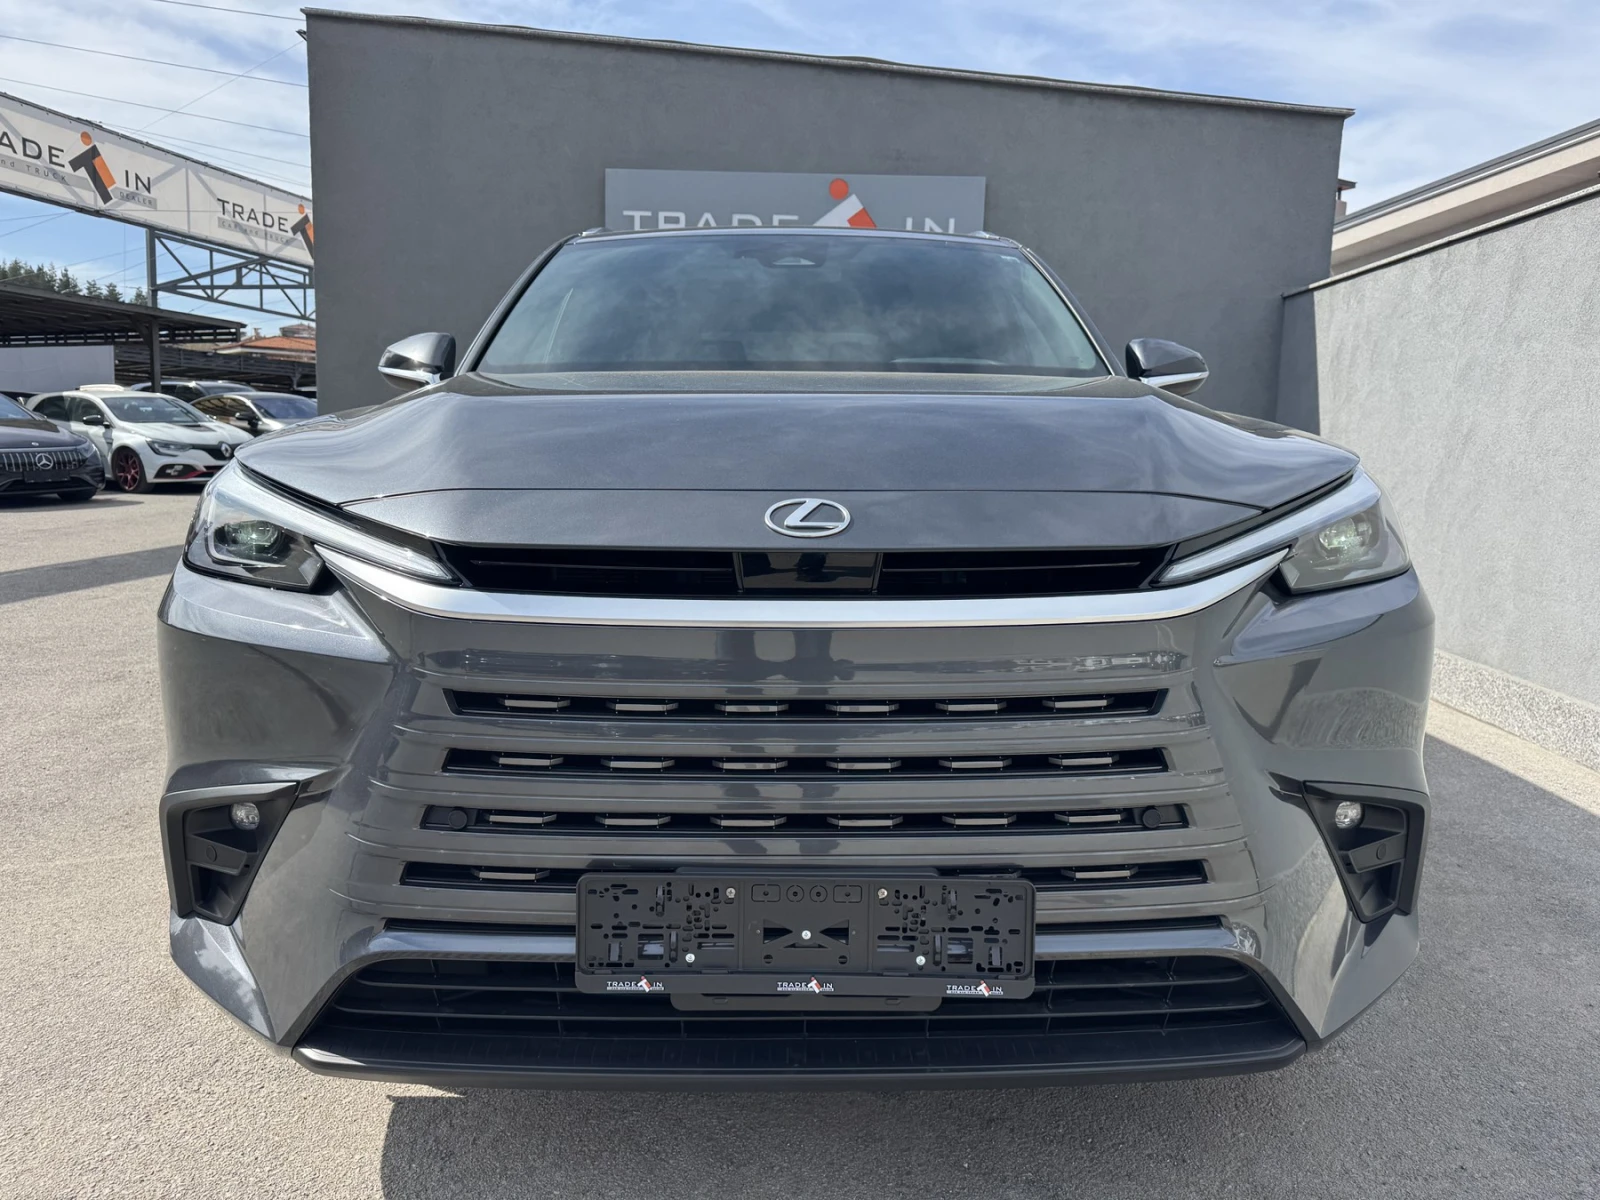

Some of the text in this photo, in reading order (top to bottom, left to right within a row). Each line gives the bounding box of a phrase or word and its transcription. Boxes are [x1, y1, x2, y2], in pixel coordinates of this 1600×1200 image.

[26, 165, 66, 182] TRUCK
[119, 191, 153, 206] DEALER
[125, 169, 151, 194] IN
[217, 198, 289, 233] TRADE
